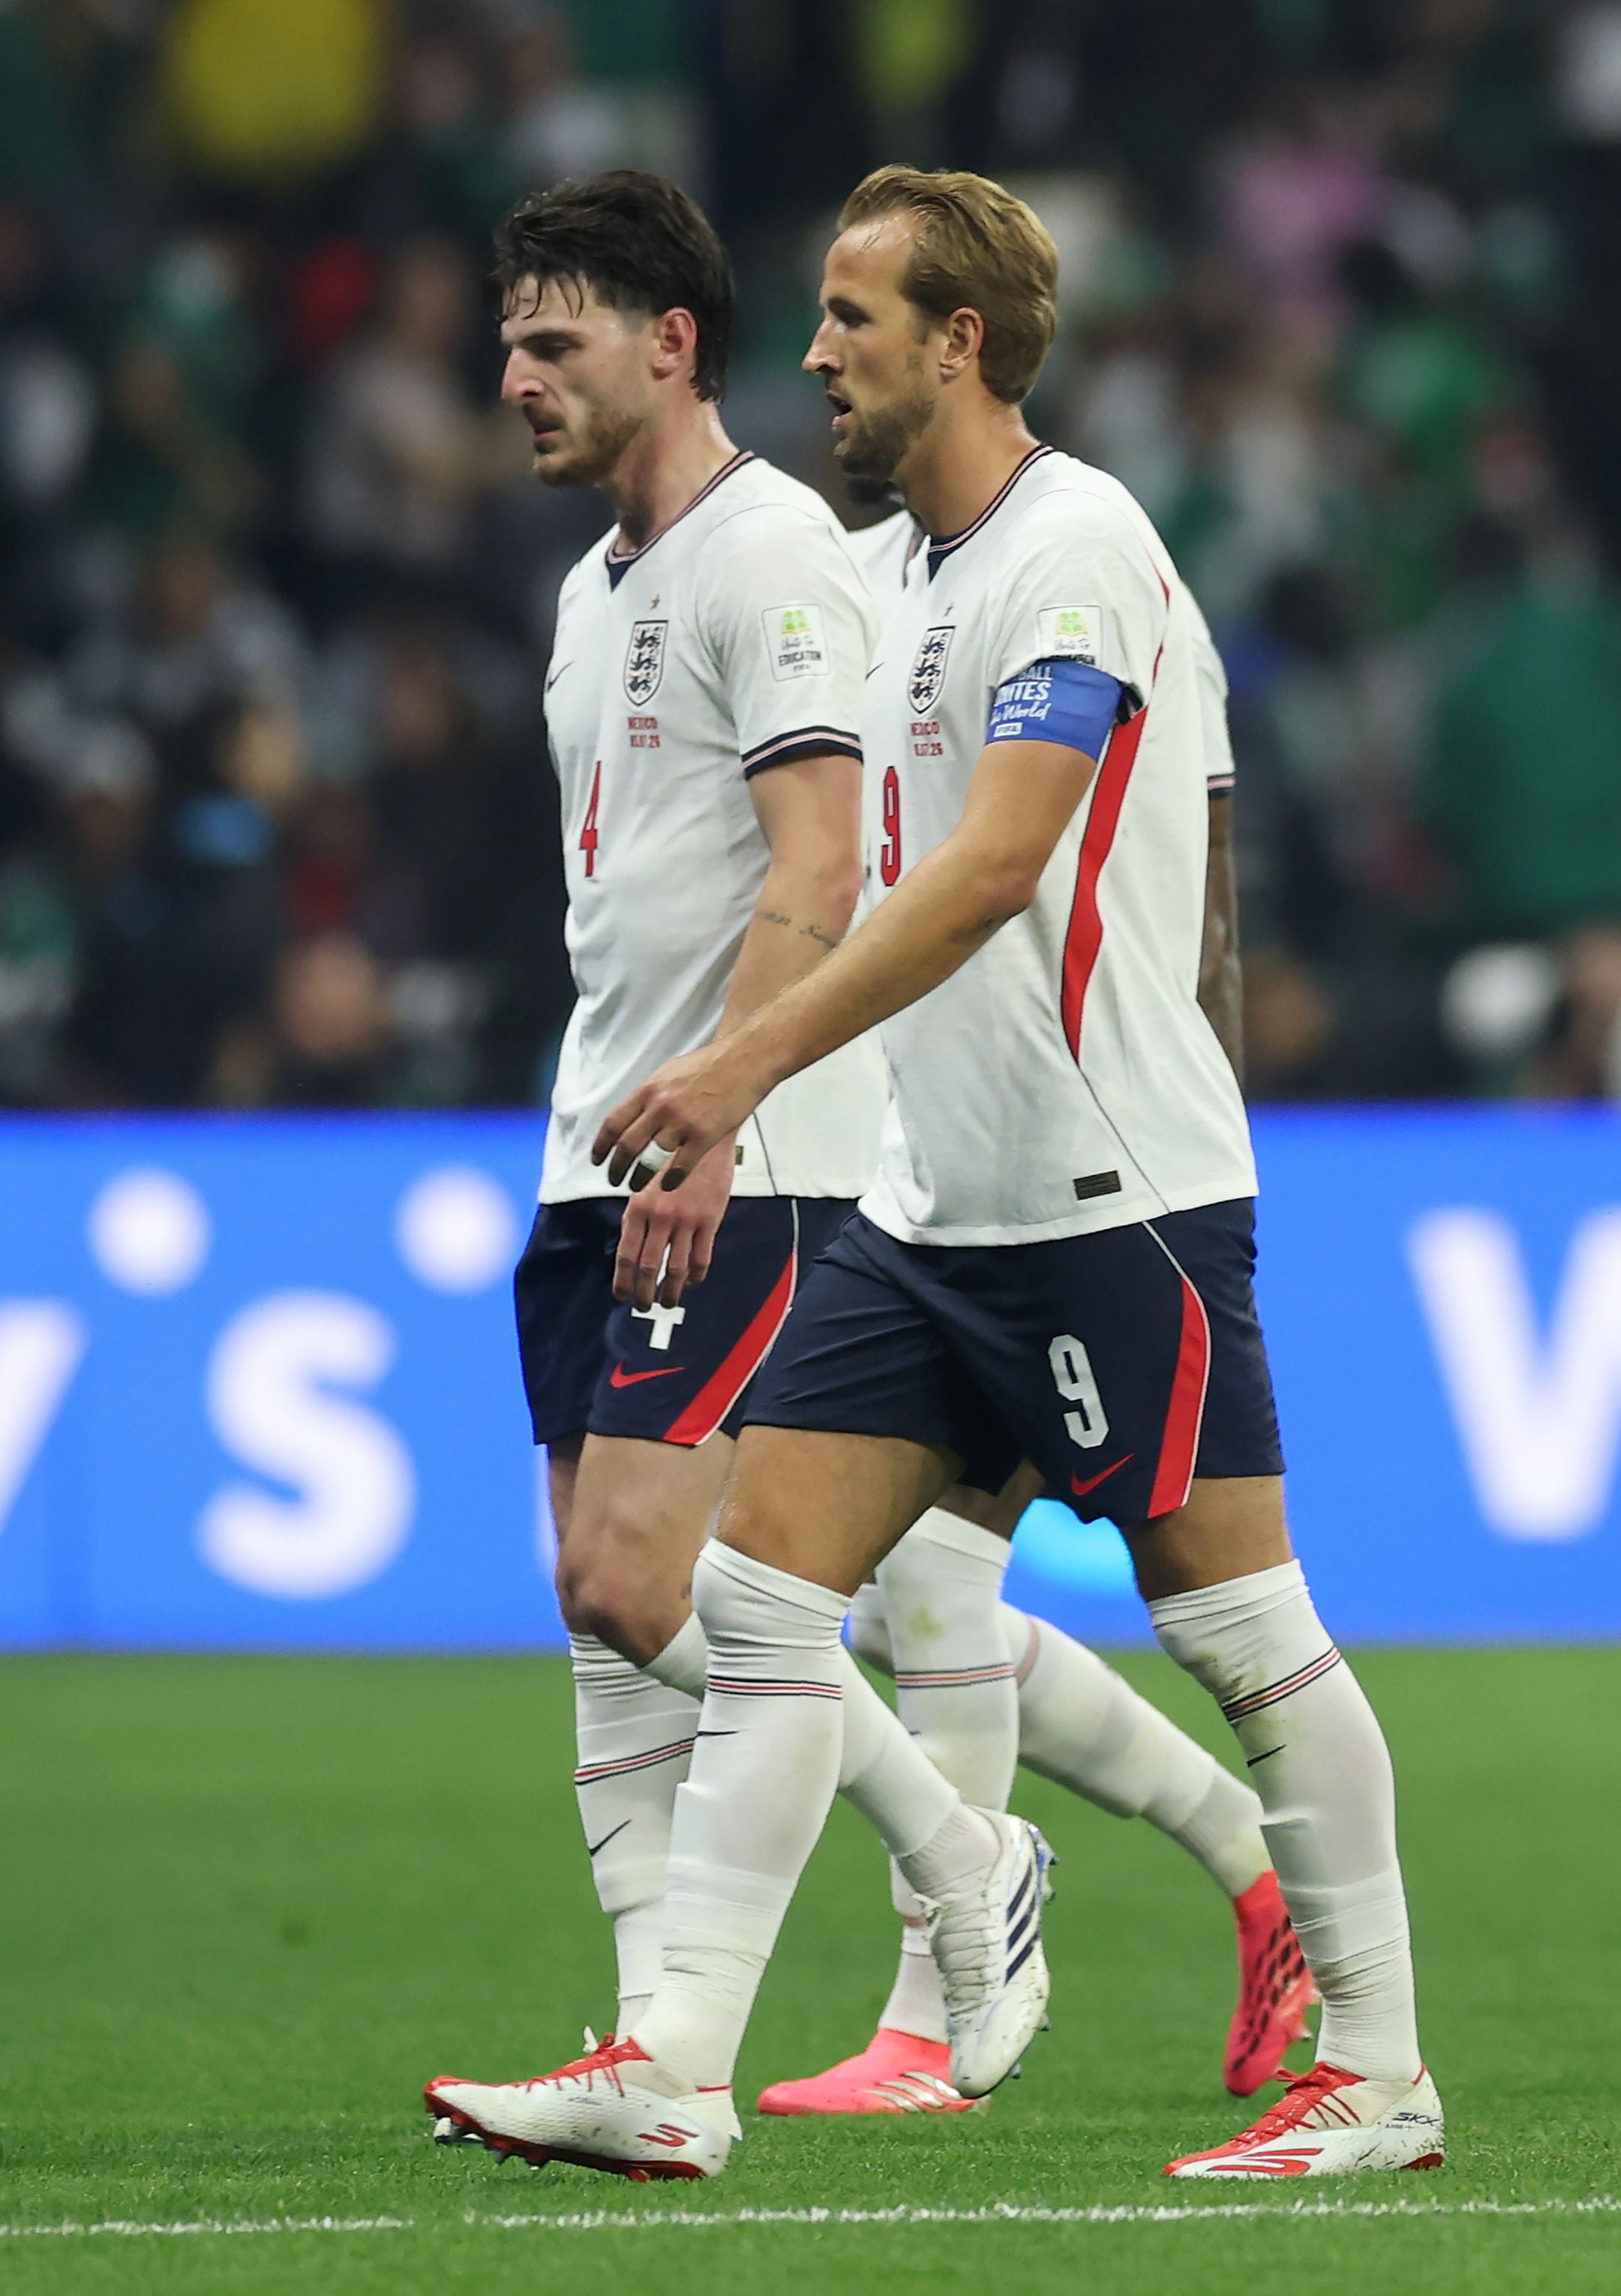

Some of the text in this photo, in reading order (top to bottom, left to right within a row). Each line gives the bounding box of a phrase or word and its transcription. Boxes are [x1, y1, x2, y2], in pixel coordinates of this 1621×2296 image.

[579, 761, 601, 877] 4
[881, 766, 900, 886] 9
[1048, 1334, 1109, 1449] 9
